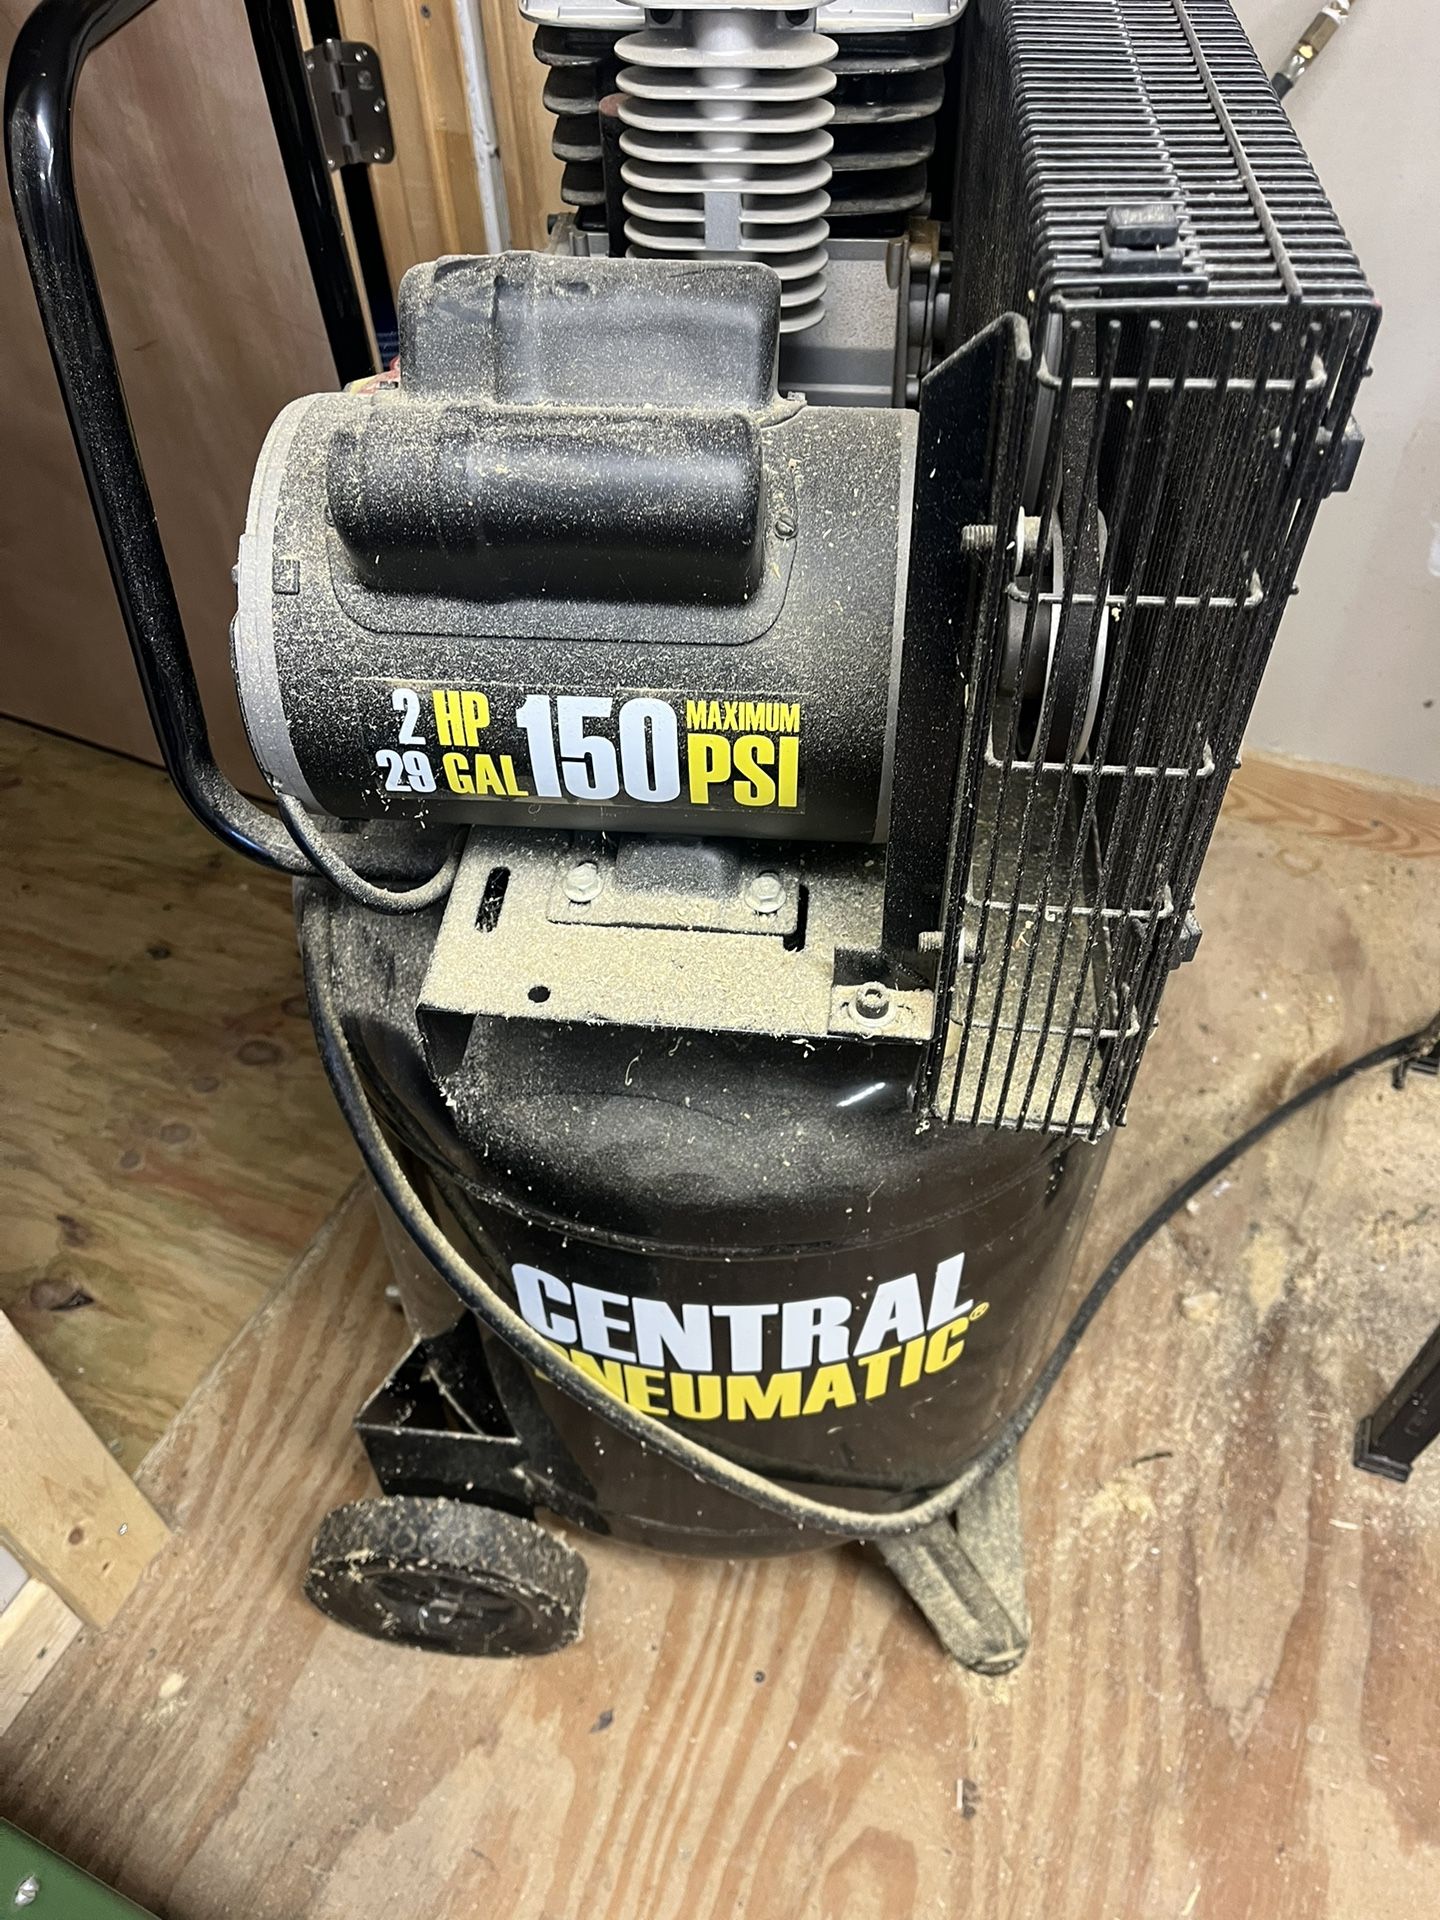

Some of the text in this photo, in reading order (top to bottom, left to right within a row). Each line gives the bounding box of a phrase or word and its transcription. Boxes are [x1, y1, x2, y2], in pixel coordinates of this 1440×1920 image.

[393, 688, 490, 747] 2 HP
[516, 695, 680, 803] 150
[686, 700, 800, 733] MAXIMUM
[375, 749, 529, 797] 29 GAL
[687, 735, 799, 808] PSI
[511, 1252, 973, 1373] CENTRAL
